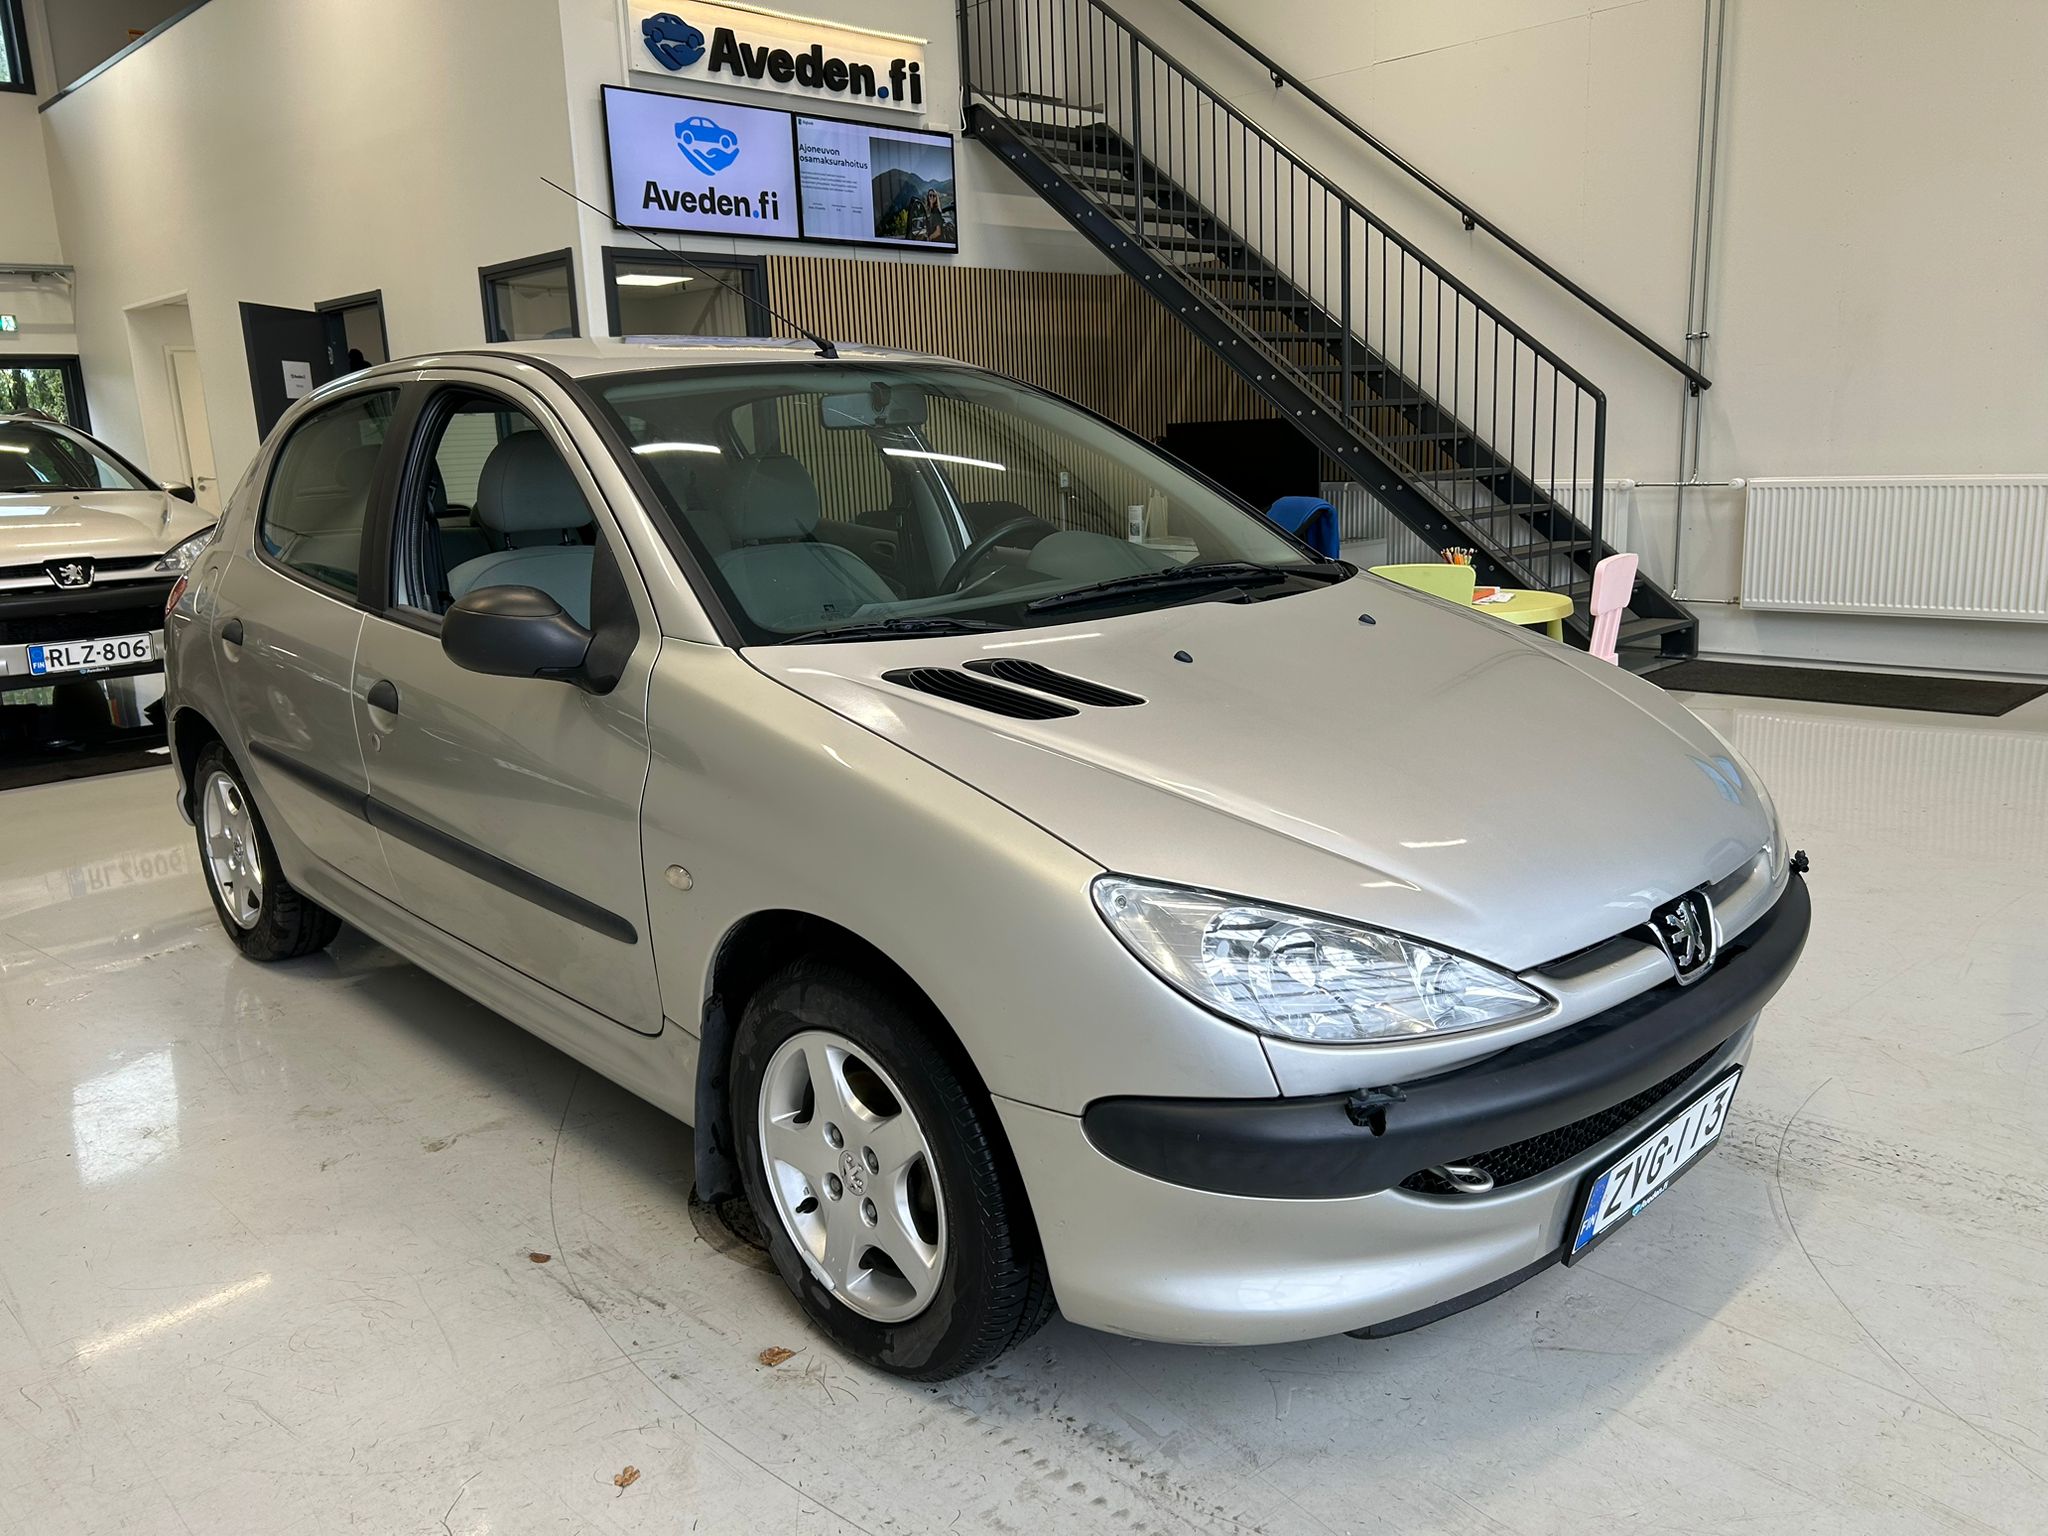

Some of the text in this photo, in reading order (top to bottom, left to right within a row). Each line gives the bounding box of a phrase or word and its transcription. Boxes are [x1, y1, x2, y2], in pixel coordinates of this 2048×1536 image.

[708, 27, 922, 104] Aveden.fi
[799, 143, 840, 156] Ajoneuvon
[799, 155, 868, 170] osamaksurahoitus
[642, 180, 779, 220] Aveden.fi
[33, 662, 45, 670] FIN
[48, 639, 146, 668] RLZ-806
[1580, 1211, 1598, 1236] FIN
